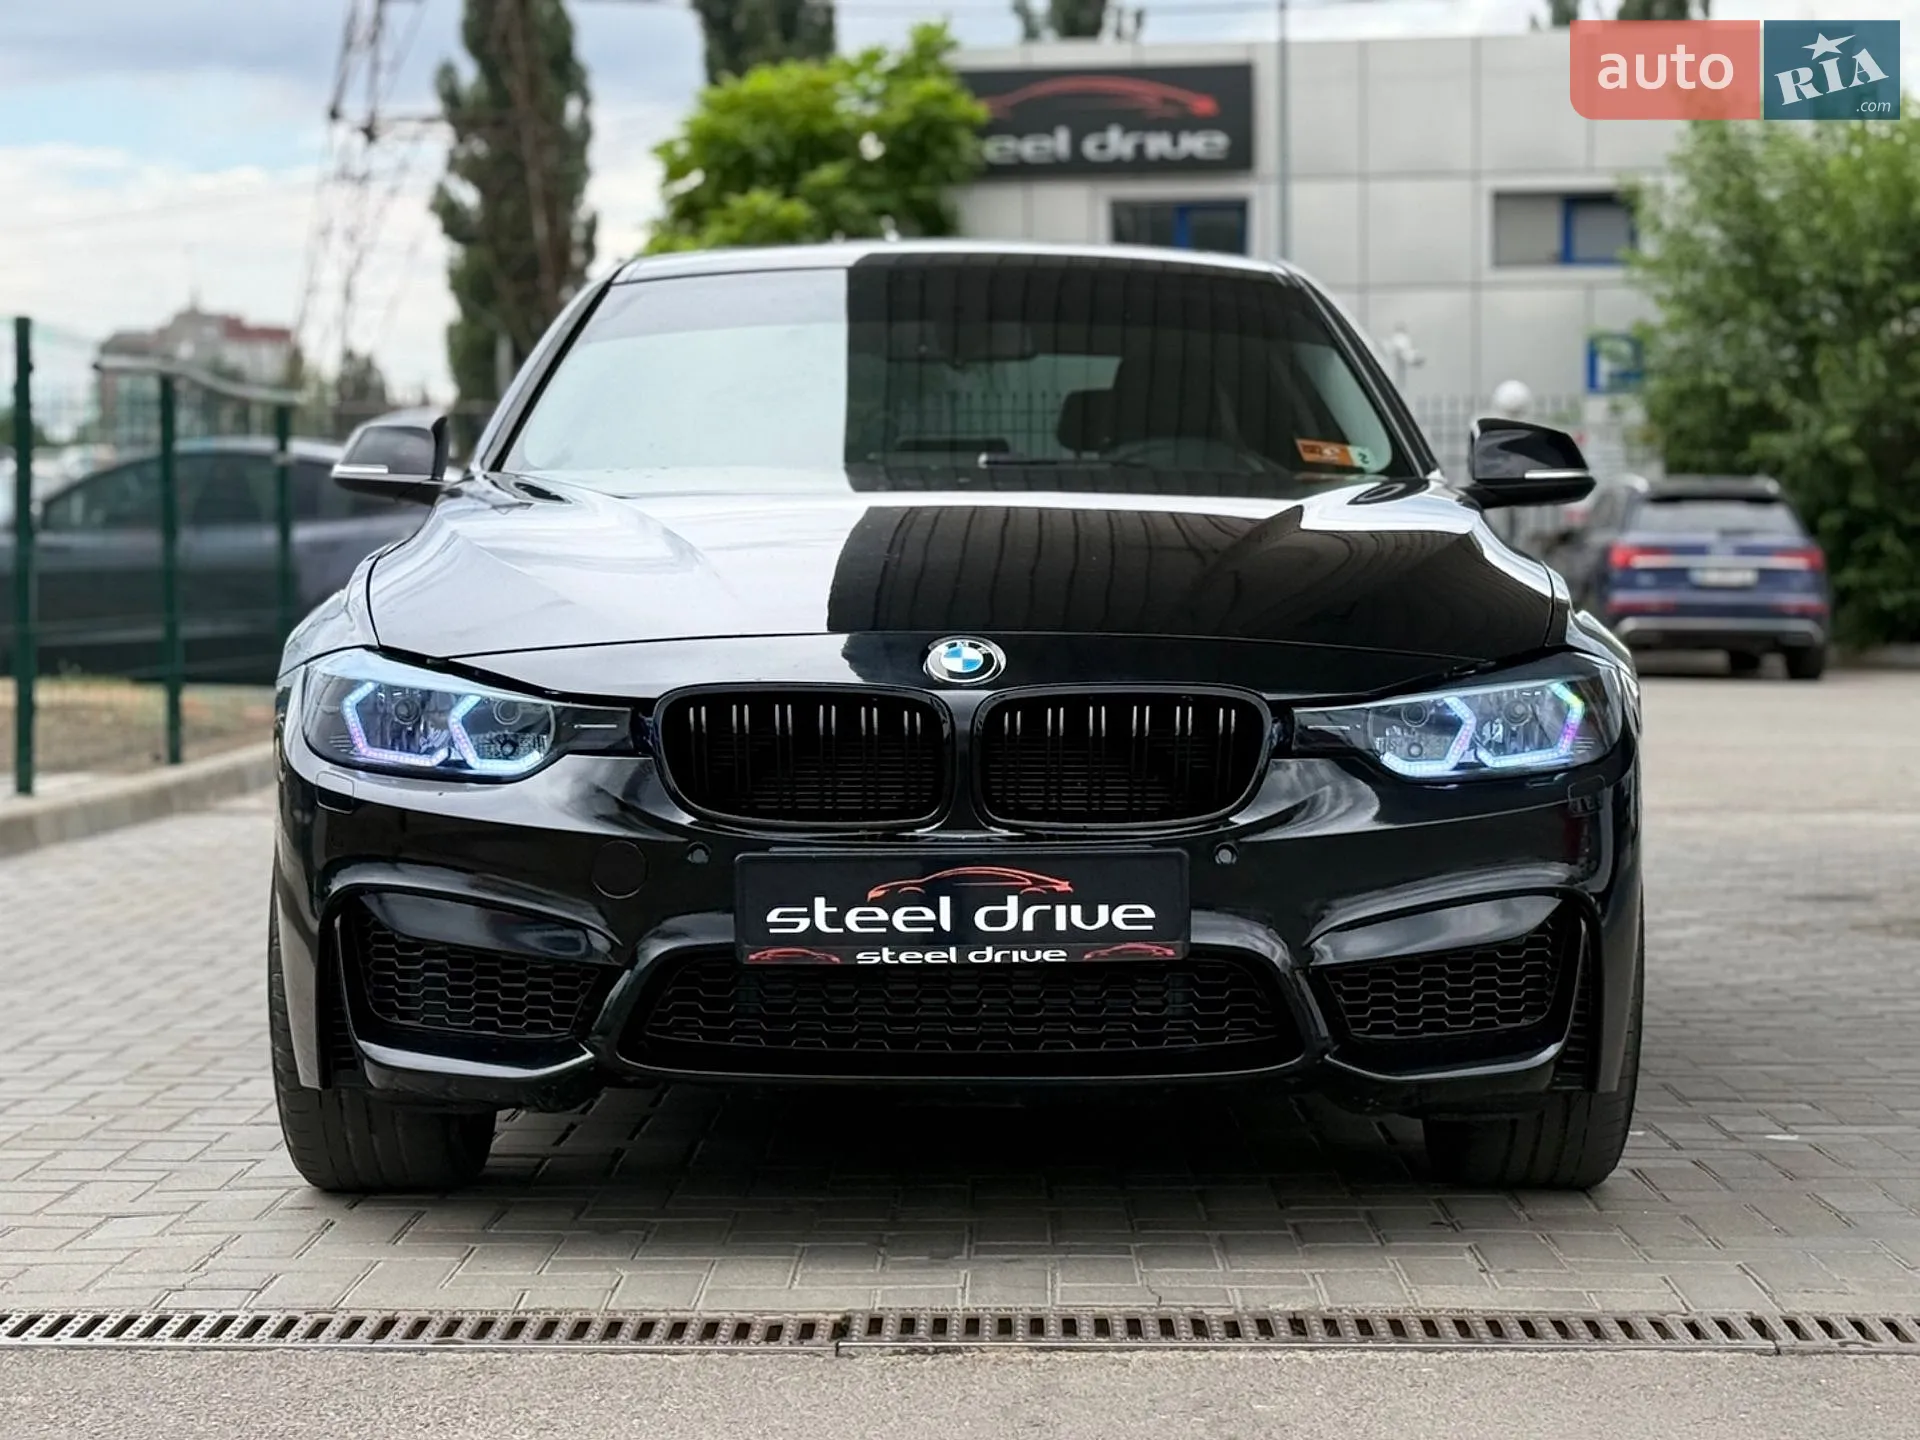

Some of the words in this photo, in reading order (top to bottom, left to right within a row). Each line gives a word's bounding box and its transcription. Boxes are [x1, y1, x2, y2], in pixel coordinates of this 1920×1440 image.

[980, 125, 1071, 164] eel
[1080, 123, 1231, 161] drive
[766, 896, 951, 933] steel
[973, 895, 1156, 932] drive
[856, 947, 957, 965] steel
[968, 945, 1067, 963] drive
